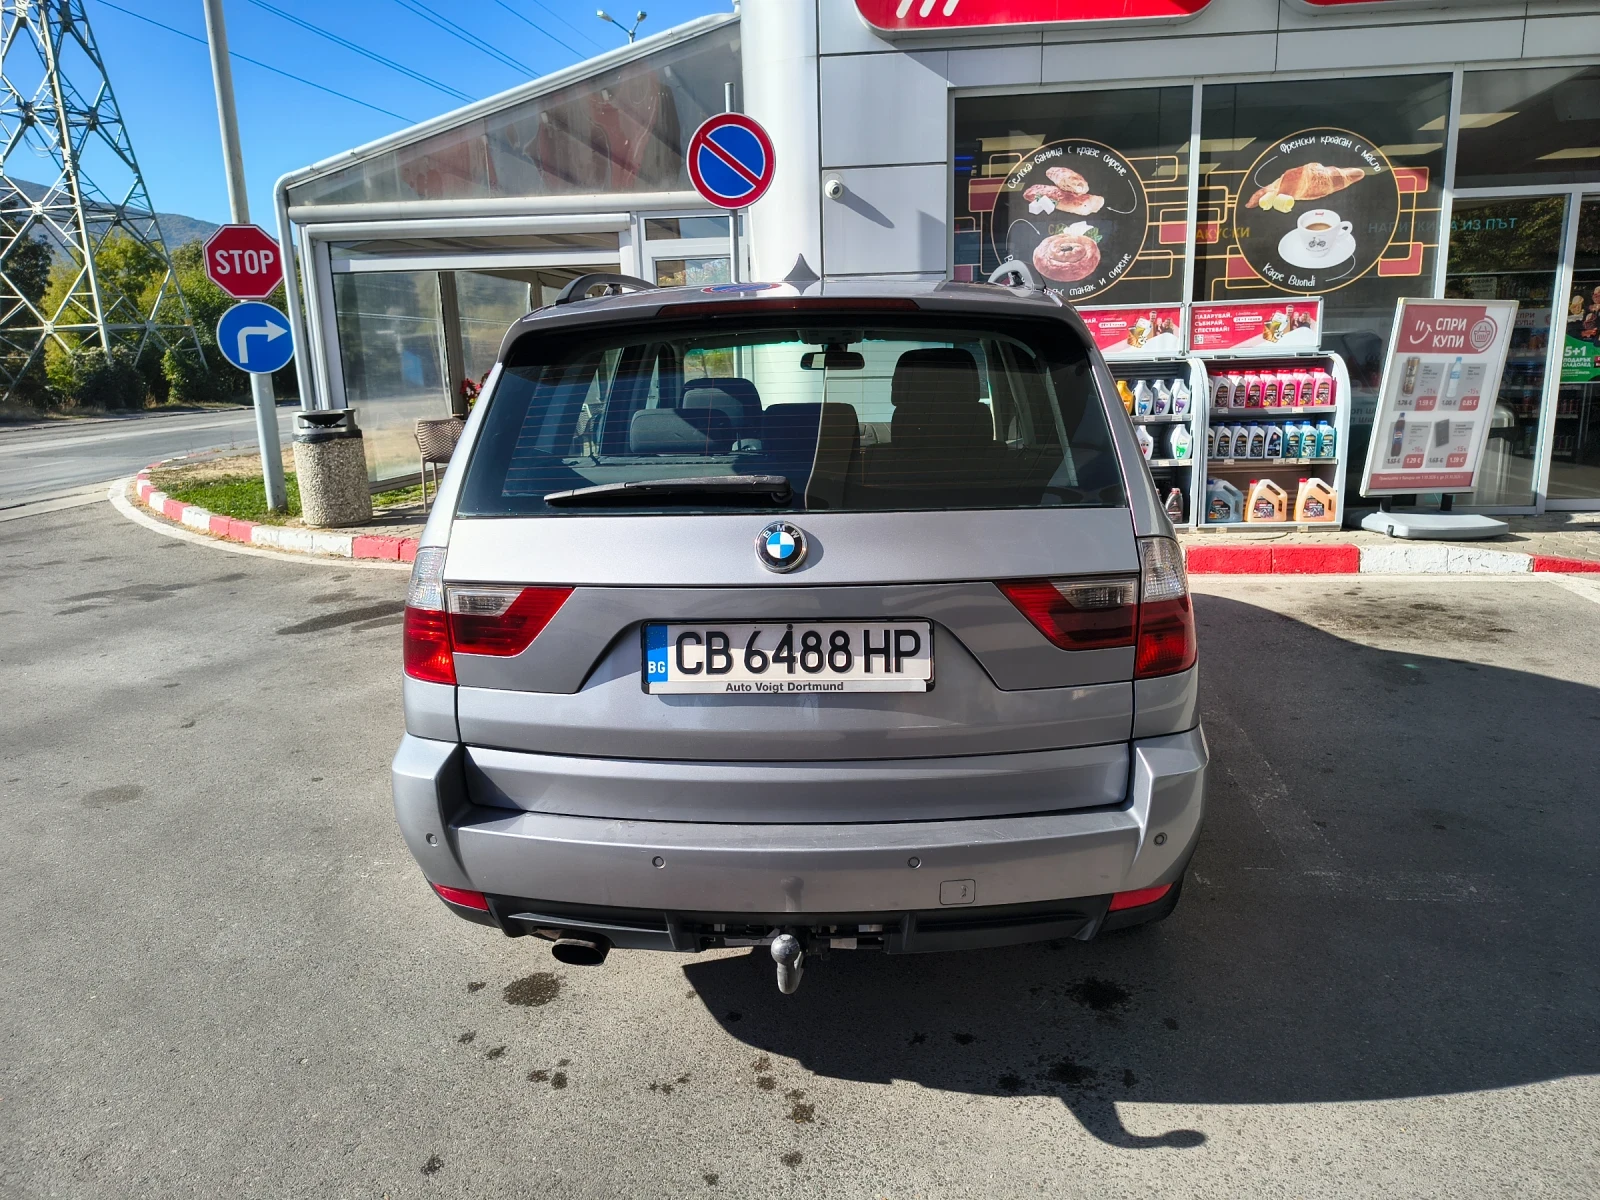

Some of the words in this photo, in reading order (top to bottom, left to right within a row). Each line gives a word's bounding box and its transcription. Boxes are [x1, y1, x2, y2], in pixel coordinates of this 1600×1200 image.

[1279, 136, 1316, 154] Френски
[1320, 136, 1353, 148] кроасан
[1354, 144, 1362, 152] с
[1360, 150, 1382, 172] масло
[1007, 163, 1033, 189] Селска
[1034, 147, 1063, 164] баница
[1067, 145, 1072, 154] с
[1076, 146, 1100, 158] краве
[1102, 154, 1127, 177] сирене
[1196, 226, 1251, 240] АКУСКИ
[1368, 220, 1436, 233] НАПИТКИ
[1463, 220, 1482, 230] ИЗ
[1485, 217, 1518, 230] ПЪТ
[215, 249, 274, 275] STOP
[1069, 284, 1096, 296] спанак
[1098, 277, 1107, 286] и
[1108, 252, 1132, 279] сирене
[1262, 262, 1285, 282] Кафе
[1287, 274, 1316, 287] Buondi
[1436, 318, 1467, 331] СПРИ
[1432, 335, 1464, 348] КУПИ
[1564, 345, 1587, 356] 5+1
[763, 525, 800, 538] BMW
[648, 661, 666, 674] BG
[675, 631, 733, 675] CB
[744, 630, 851, 674] 6488
[863, 629, 921, 673] HP
[726, 682, 752, 692] Auto
[755, 682, 784, 694] Voigt
[787, 681, 844, 692] Dortmund
